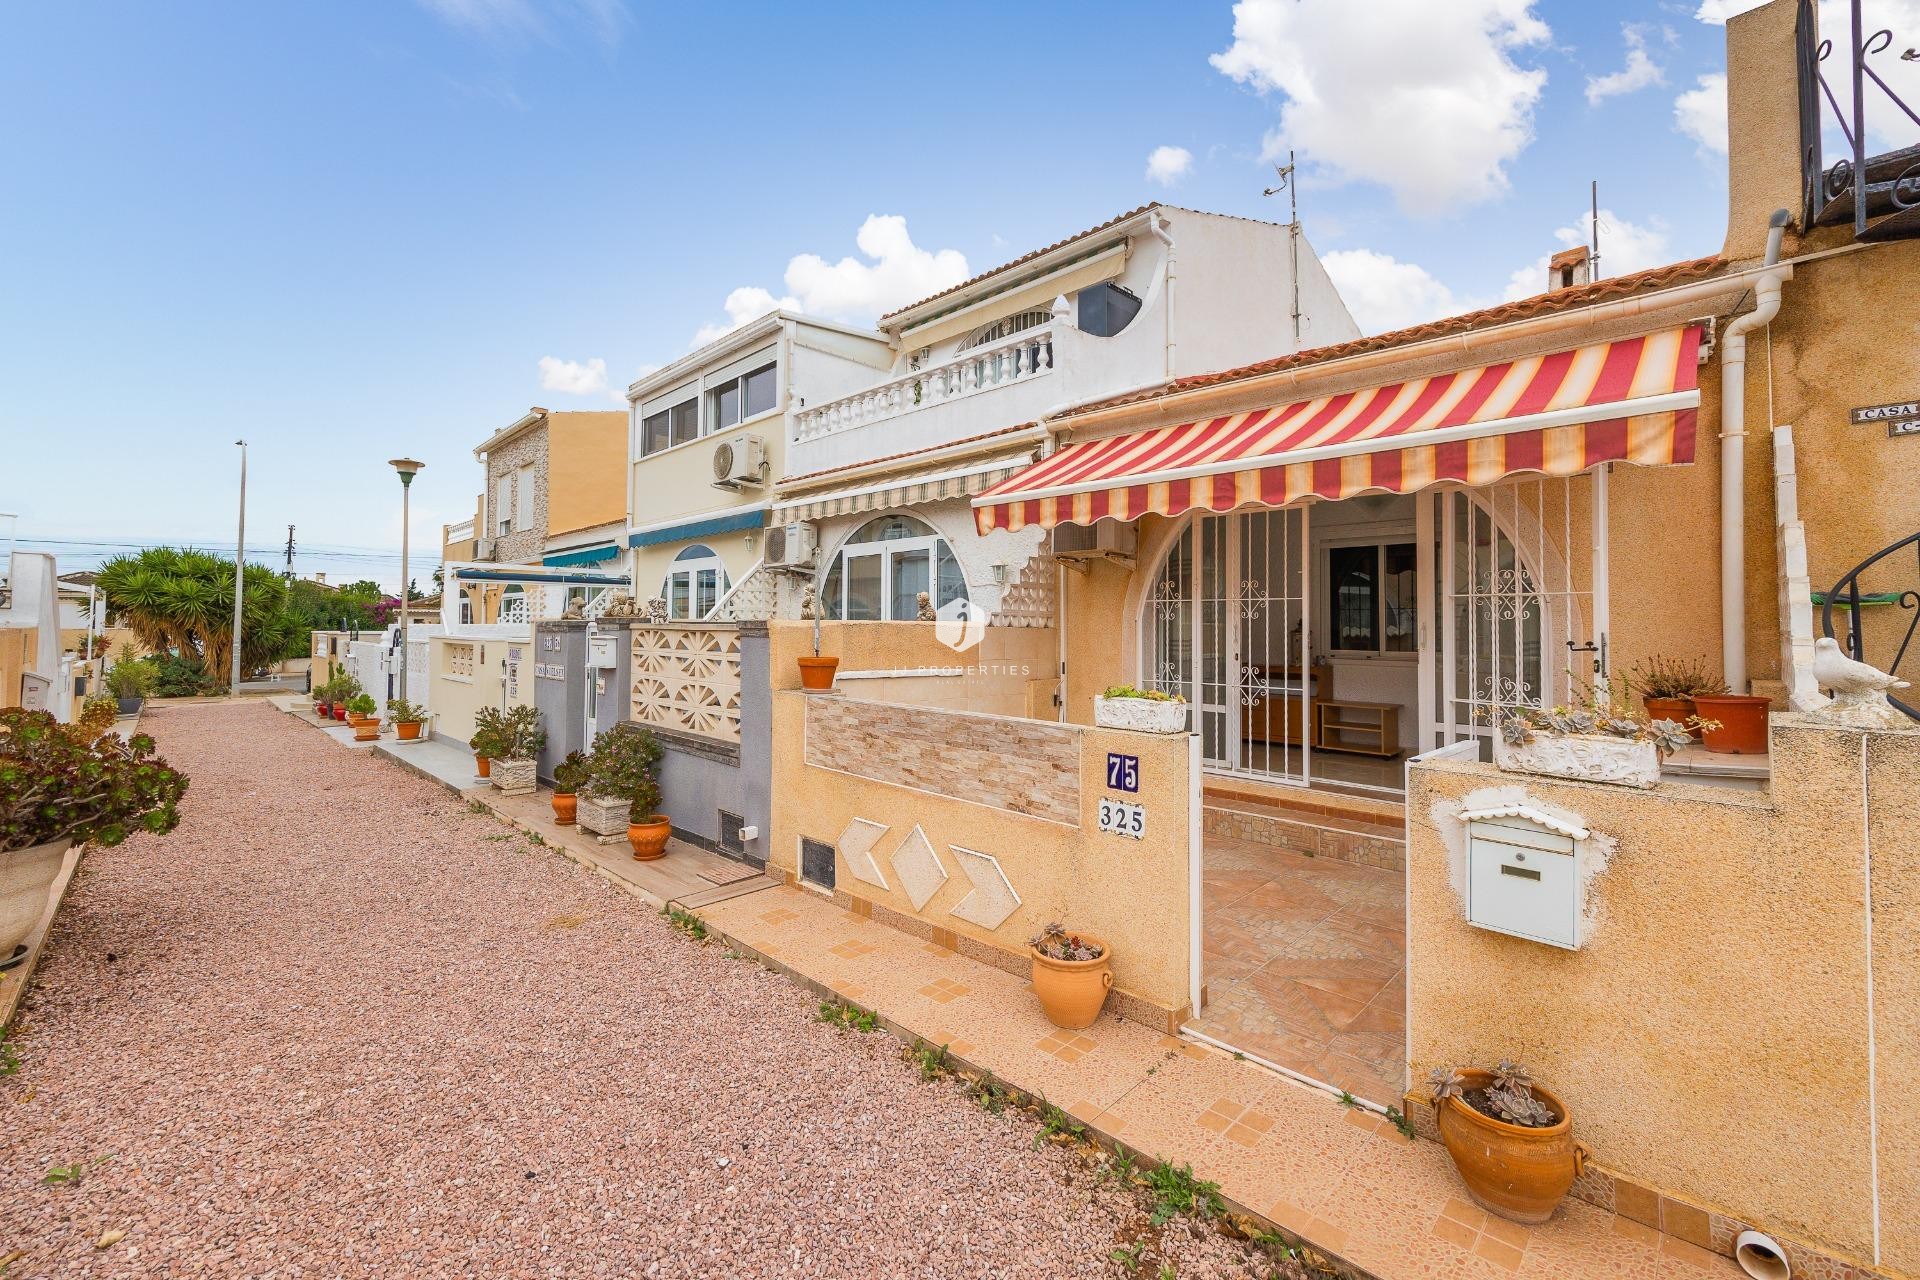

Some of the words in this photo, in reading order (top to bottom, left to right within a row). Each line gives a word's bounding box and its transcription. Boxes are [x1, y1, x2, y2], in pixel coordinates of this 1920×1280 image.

[1865, 406, 1911, 418] CASA
[1109, 756, 1137, 789] 75
[1100, 805, 1143, 832] 325
